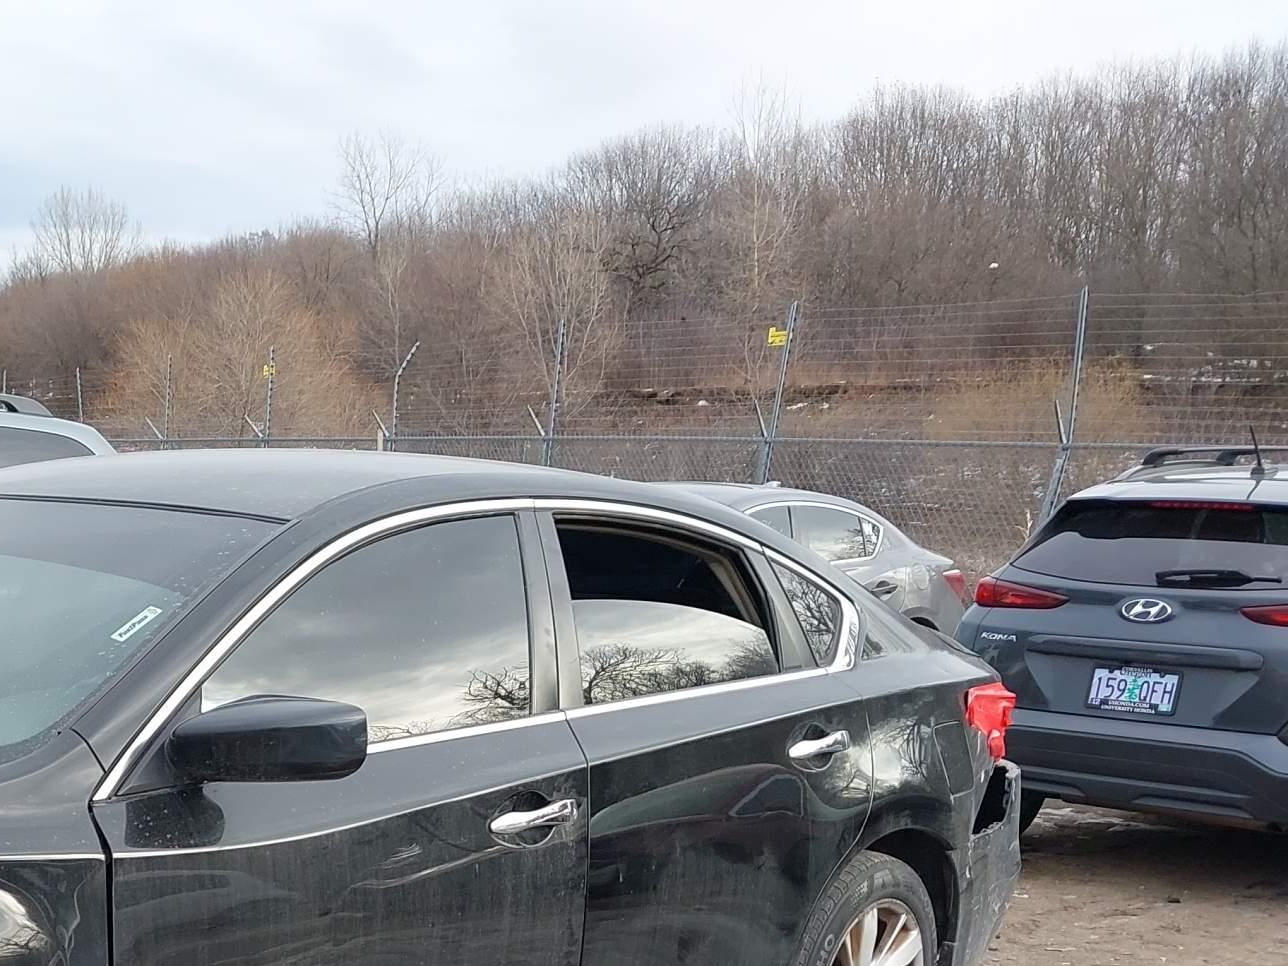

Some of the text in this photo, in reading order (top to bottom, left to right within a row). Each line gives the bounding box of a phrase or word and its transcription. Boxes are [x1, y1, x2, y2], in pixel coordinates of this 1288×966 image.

[981, 631, 1017, 642] KONA
[1096, 676, 1175, 705] 159 QFH
